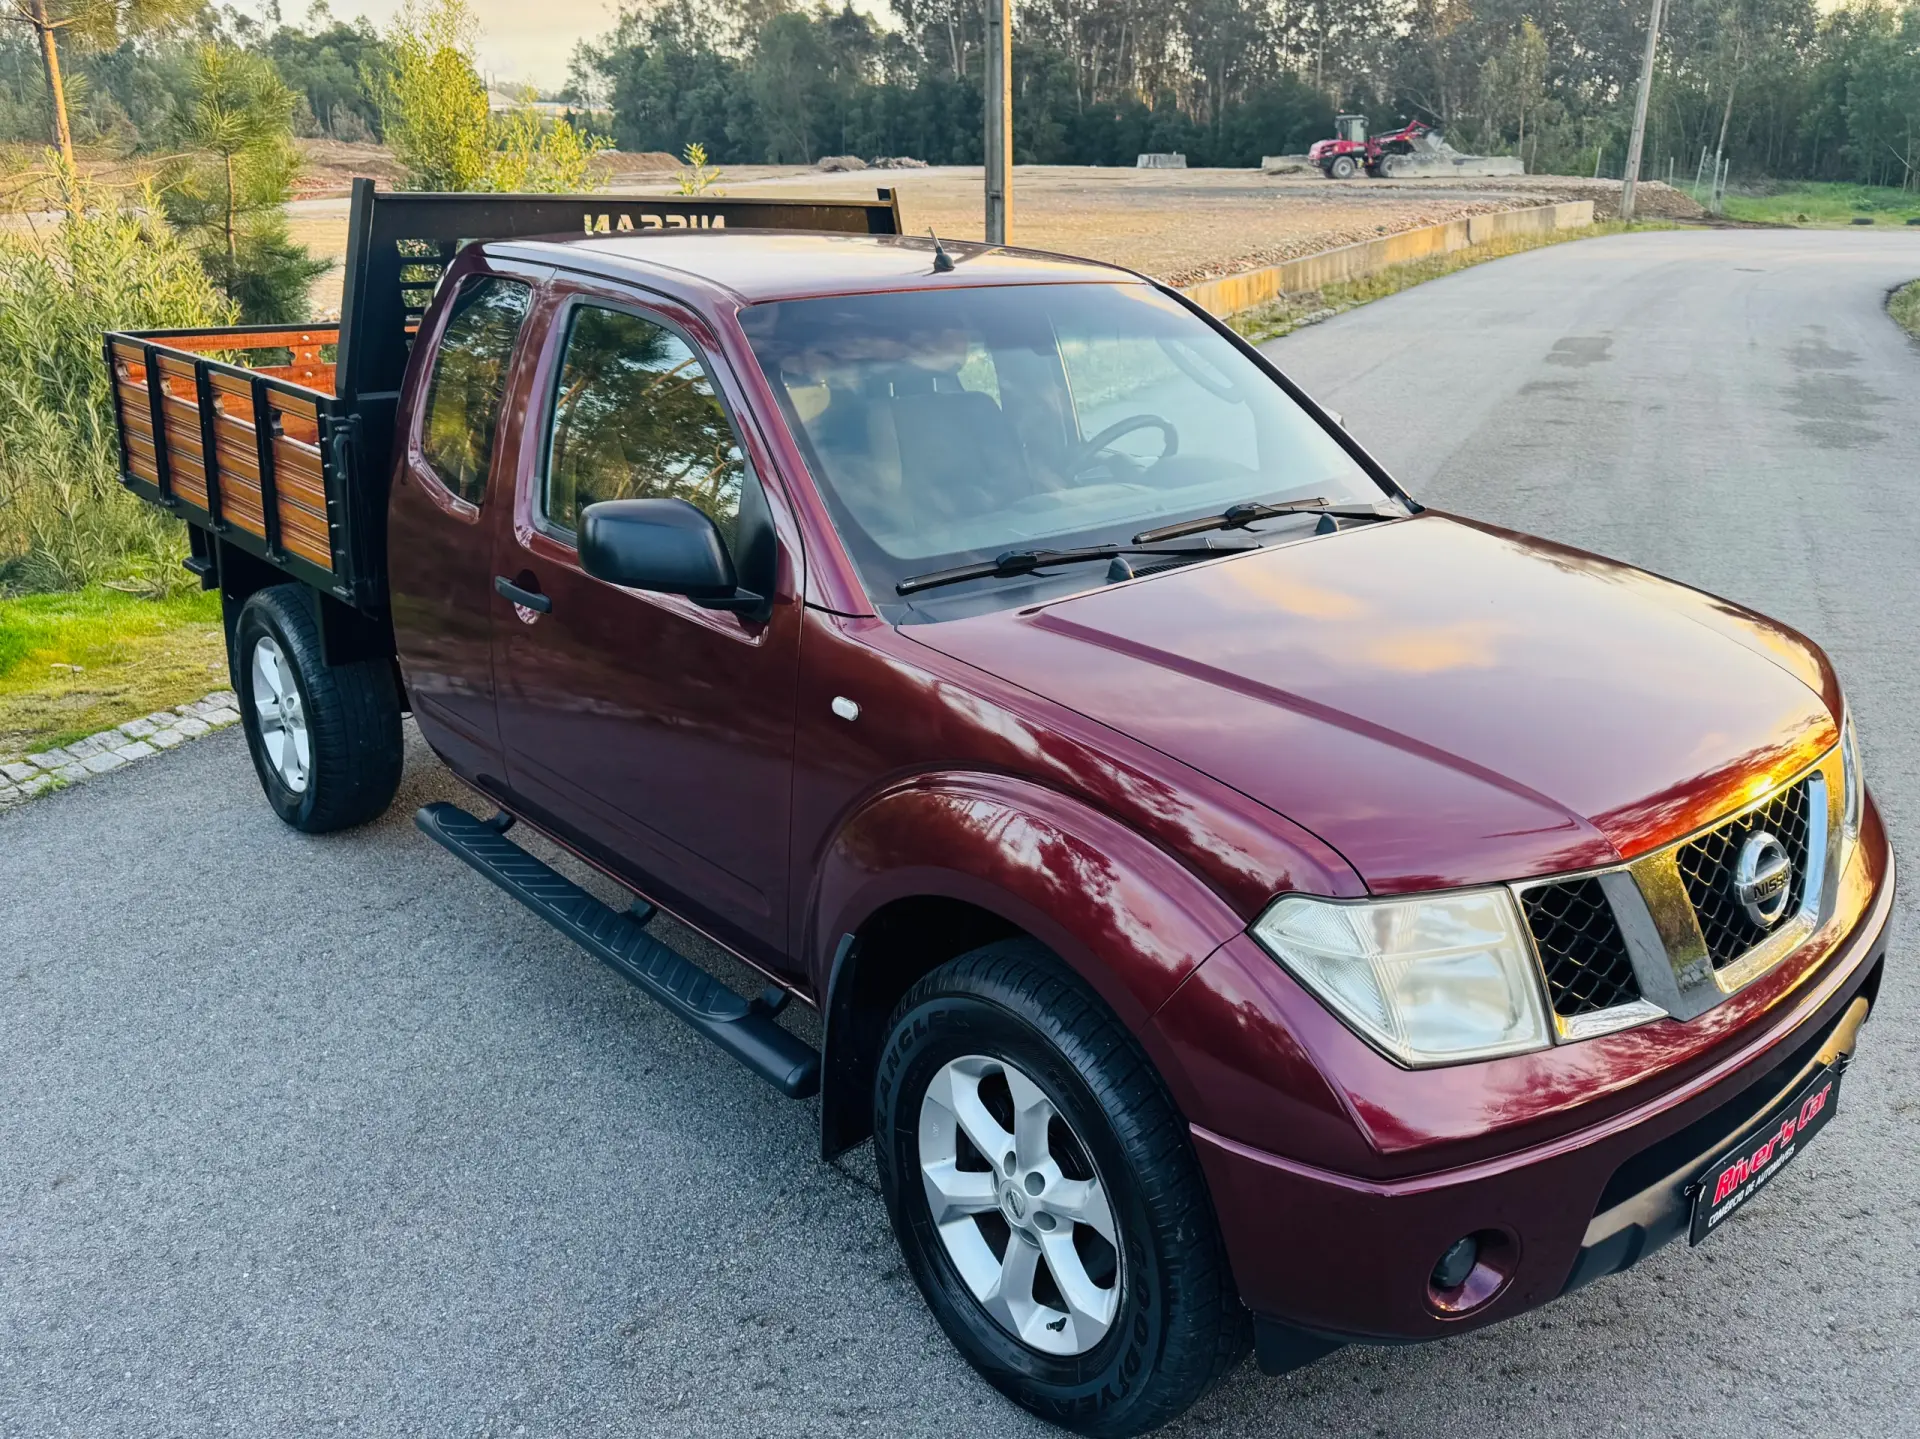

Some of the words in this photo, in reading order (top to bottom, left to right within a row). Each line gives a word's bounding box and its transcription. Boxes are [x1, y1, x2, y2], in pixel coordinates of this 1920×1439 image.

[1712, 1117, 1797, 1207] River's
[1796, 1081, 1833, 1132] Car
[1744, 1179, 1756, 1197] DE
